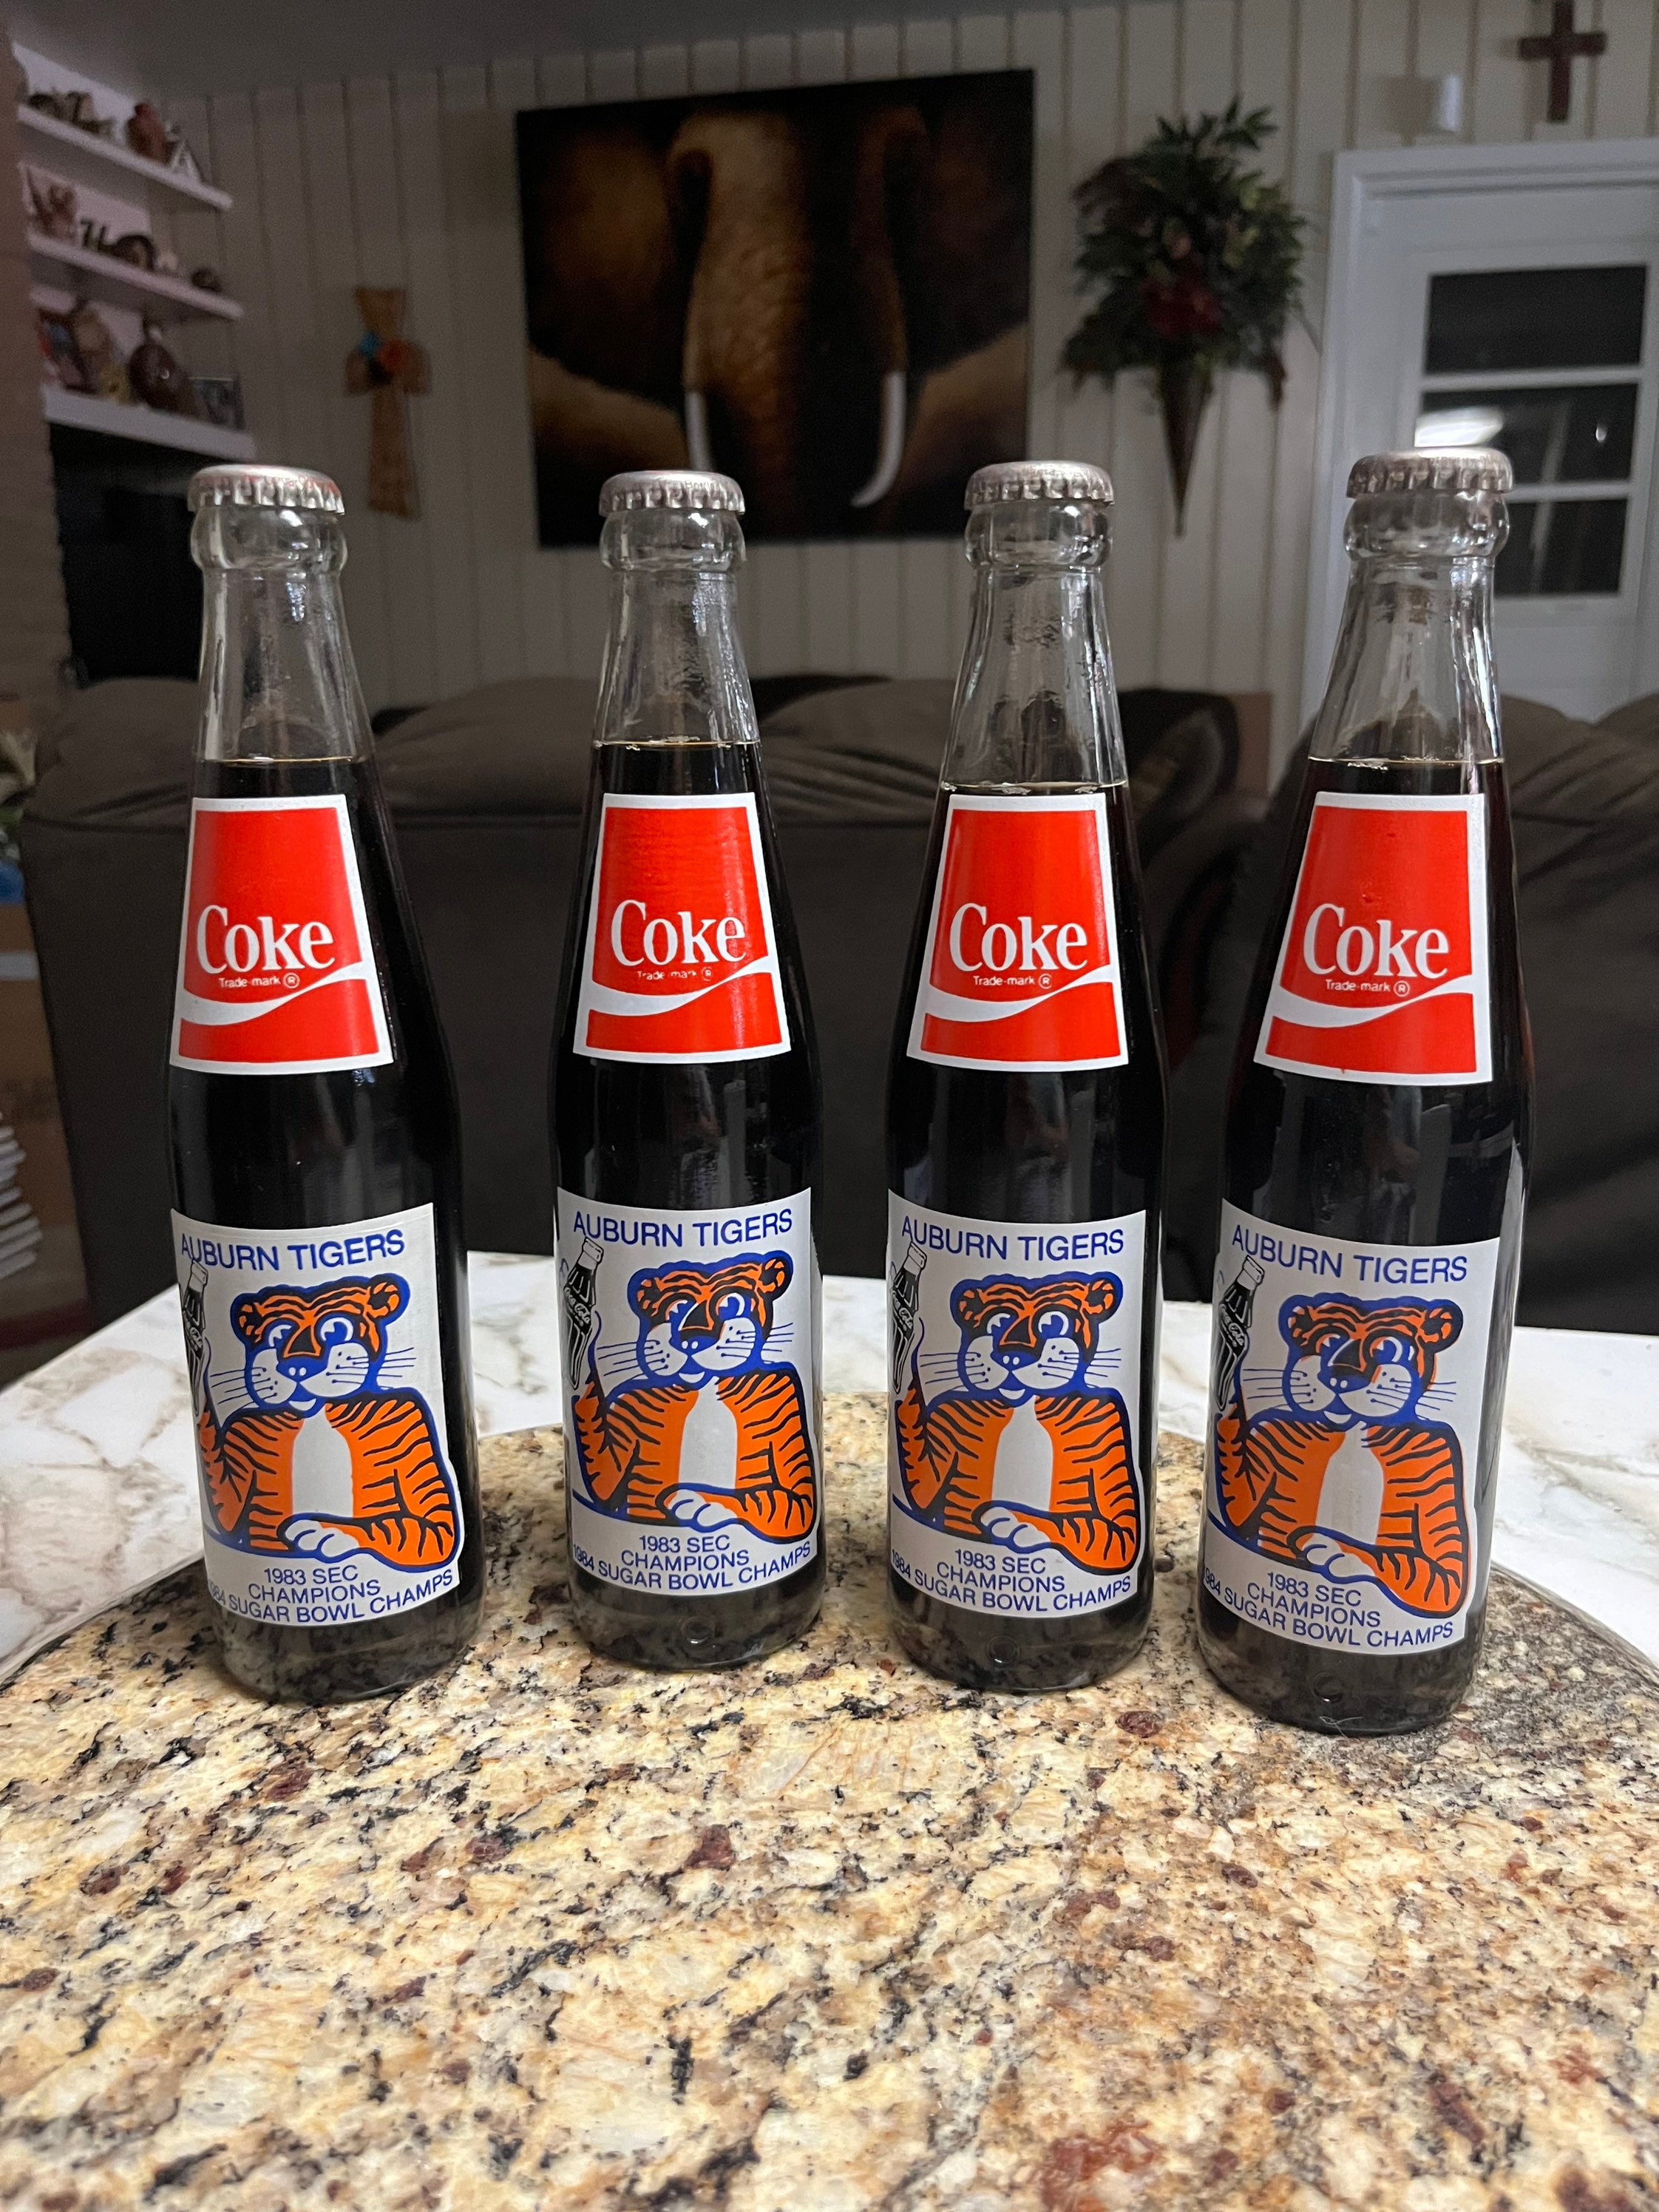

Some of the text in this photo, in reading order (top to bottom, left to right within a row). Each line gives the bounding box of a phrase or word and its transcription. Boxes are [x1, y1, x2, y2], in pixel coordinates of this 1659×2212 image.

[197, 904, 335, 974] Coke
[611, 900, 746, 966] Coke
[949, 903, 1088, 971] Coke
[1303, 903, 1449, 979] Coke
[219, 975, 281, 988] Trade-mark
[973, 975, 1035, 986] Trade-mark
[1326, 979, 1391, 991] Trade-mark
[574, 1209, 793, 1247] AUBURN TIGERS
[902, 1215, 1124, 1261] AUBURN TIGERS
[181, 1229, 405, 1271] AUBURN TIGERS
[1232, 1224, 1468, 1284] AUBURN TIGERS
[621, 1550, 749, 1571] CHAMPIONS
[639, 1535, 730, 1553] 1983 SEC
[955, 1549, 1045, 1574] 1983 SEC
[265, 1564, 358, 1585] 1983 SEC
[574, 1541, 810, 1590] 1984 SUGAR BOWL CHAMPS
[892, 1549, 1130, 1612] 1984 SUGAR BOWL CHAMPS
[937, 1561, 1065, 1592] CHAMPIONS
[228, 1594, 290, 1622] SUGAR
[296, 1603, 365, 1622] BOWL
[370, 1569, 452, 1613] CHAMPS
[248, 1579, 381, 1604] CHAMPIONS
[1205, 1567, 1453, 1646] 984 SUGAR BOWL CHAMPS
[1247, 1582, 1380, 1627] CHAMPIONS
[1267, 1572, 1361, 1607] 1983 SEC
